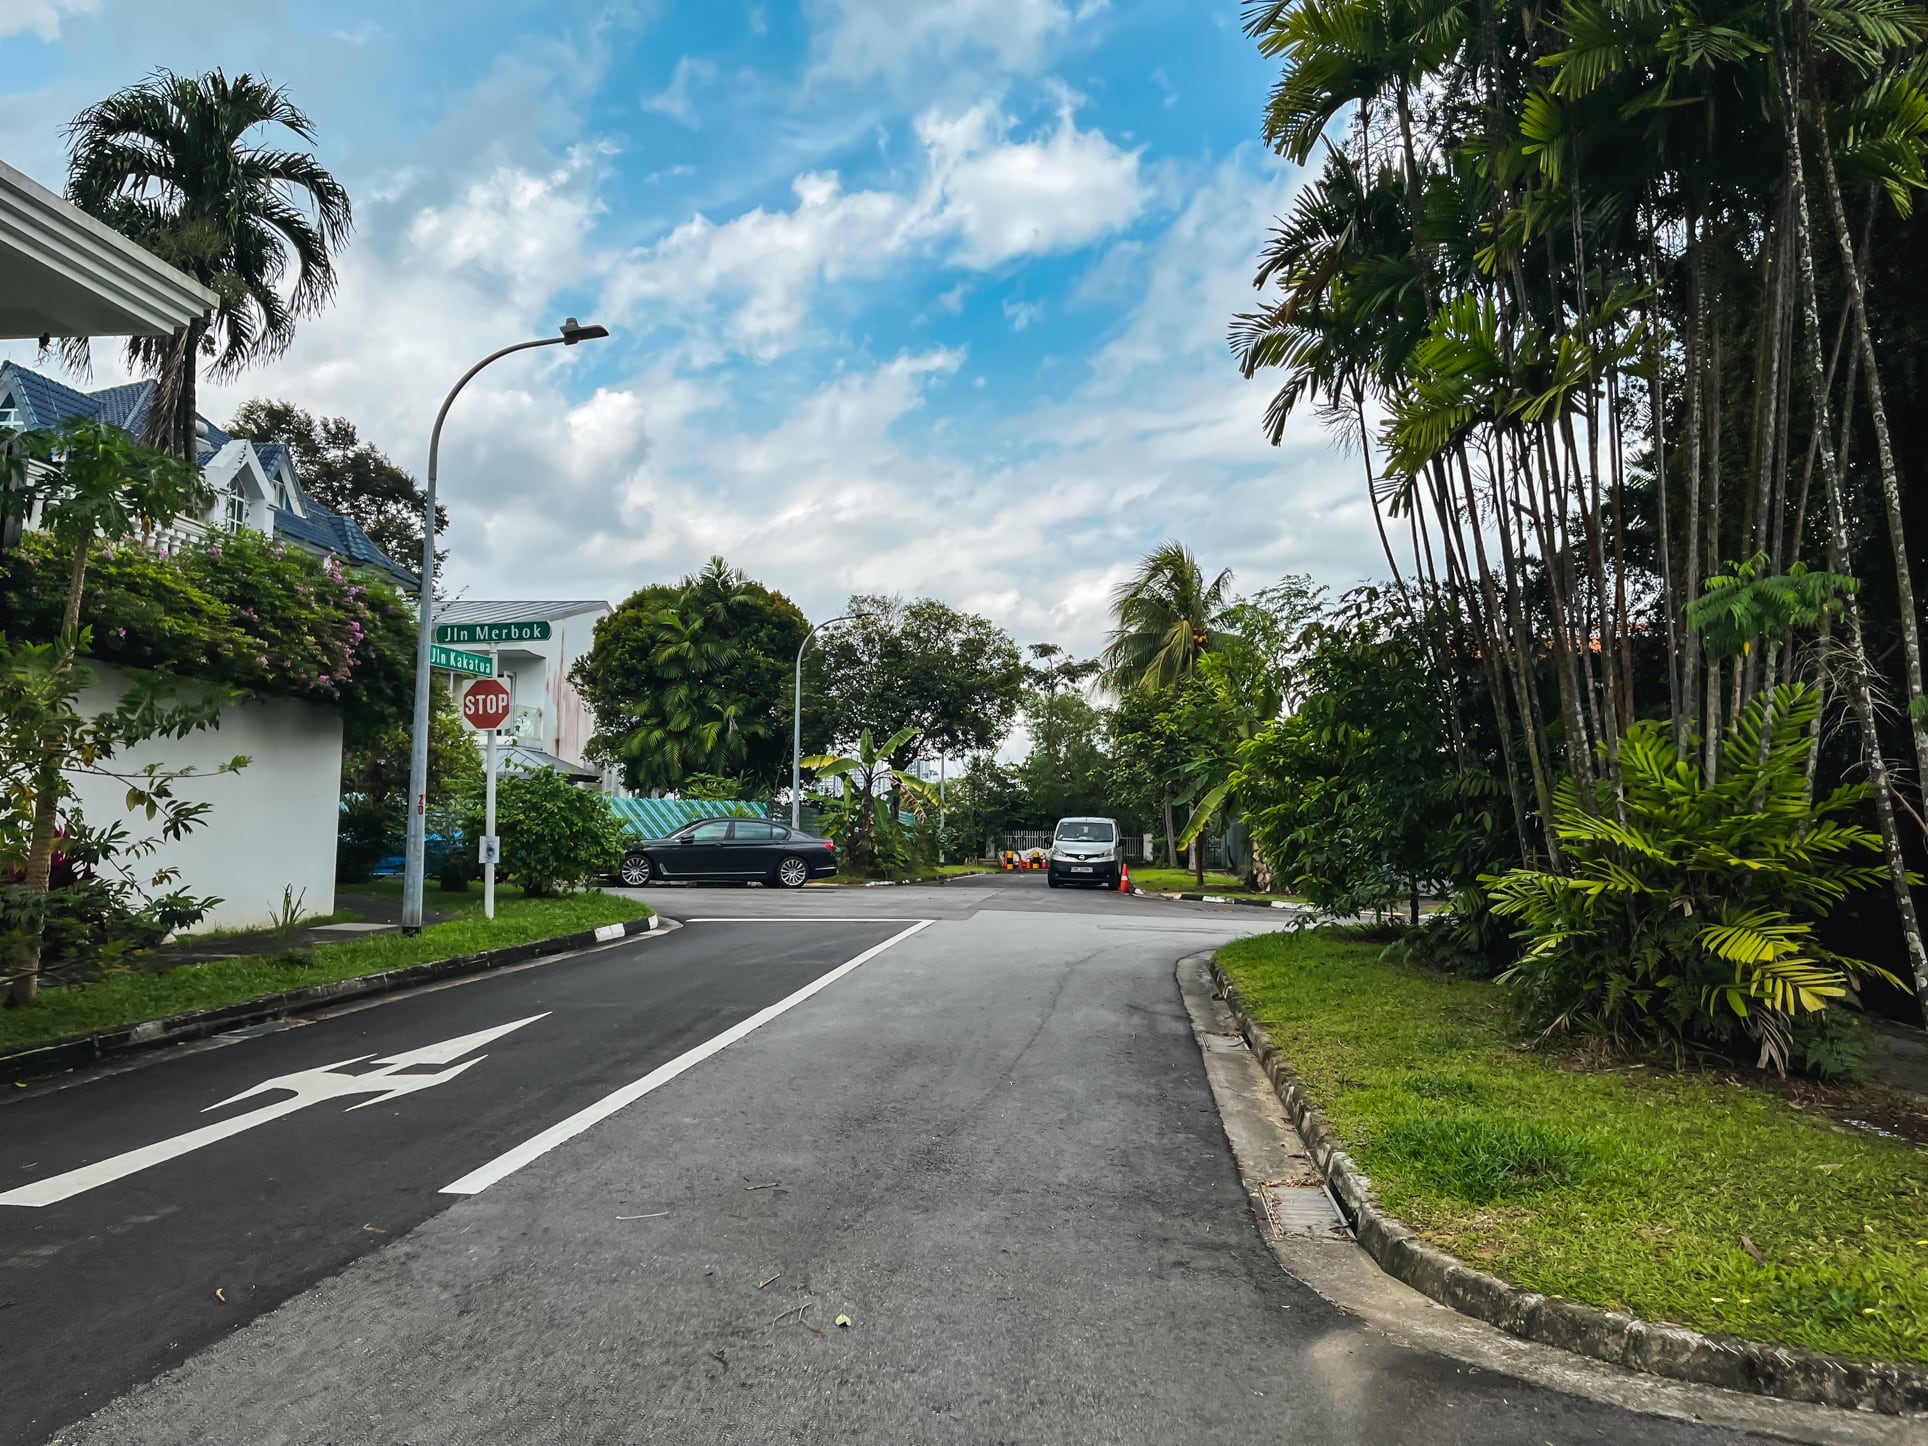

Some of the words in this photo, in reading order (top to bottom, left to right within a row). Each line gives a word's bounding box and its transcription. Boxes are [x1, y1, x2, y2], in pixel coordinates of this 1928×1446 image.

[444, 627, 468, 642] Jln
[476, 624, 542, 640] Merbok
[431, 648, 446, 664] Jln
[450, 651, 491, 674] Kakatua
[465, 694, 508, 715] STOP
